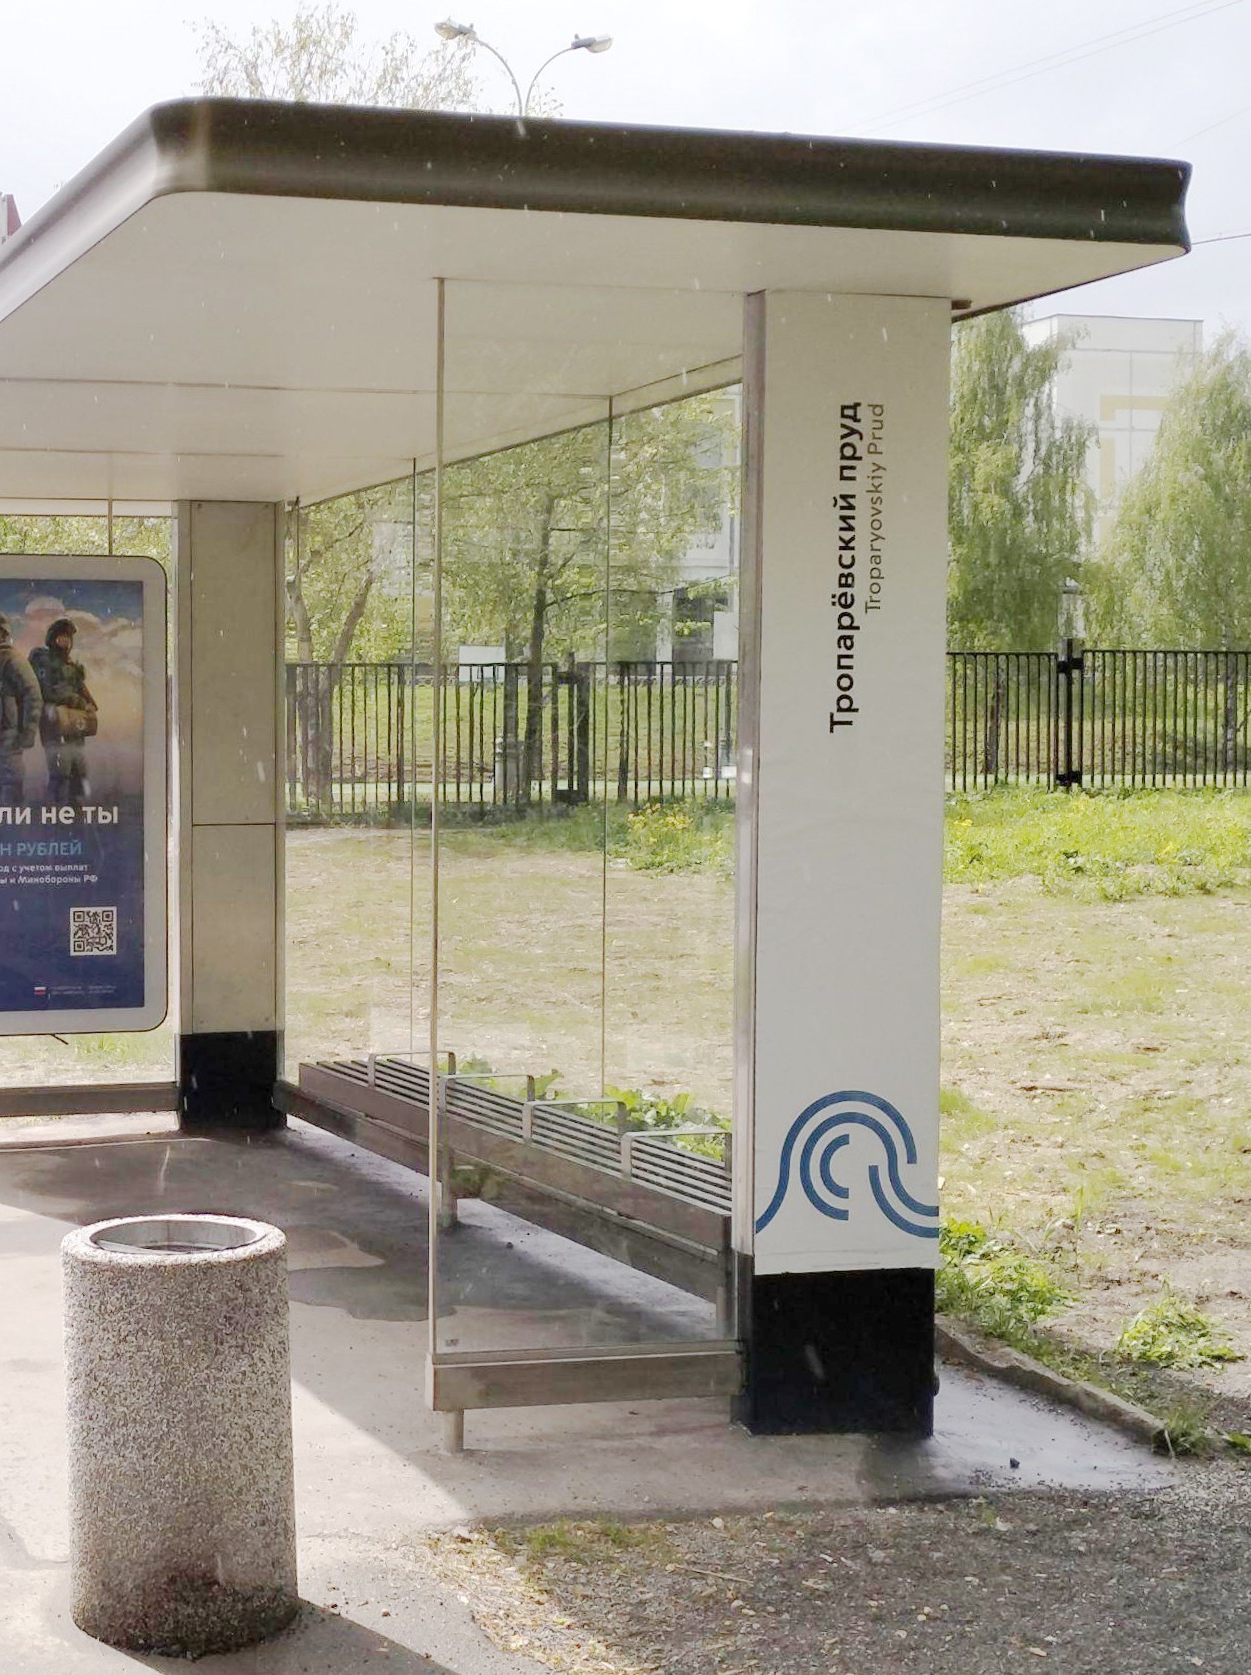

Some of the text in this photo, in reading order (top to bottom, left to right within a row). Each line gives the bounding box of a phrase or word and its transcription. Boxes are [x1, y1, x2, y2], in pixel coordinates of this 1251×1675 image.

[864, 404, 886, 614] Troparyovskiy Prud
[829, 401, 863, 734] Тропарёвский пруд
[41, 805, 76, 825] не
[82, 805, 119, 825] ты
[17, 839, 82, 856] РУБЛЕЙ
[18, 865, 53, 873] учетом
[17, 874, 81, 885] Минобороны
[83, 874, 98, 883] РФ
